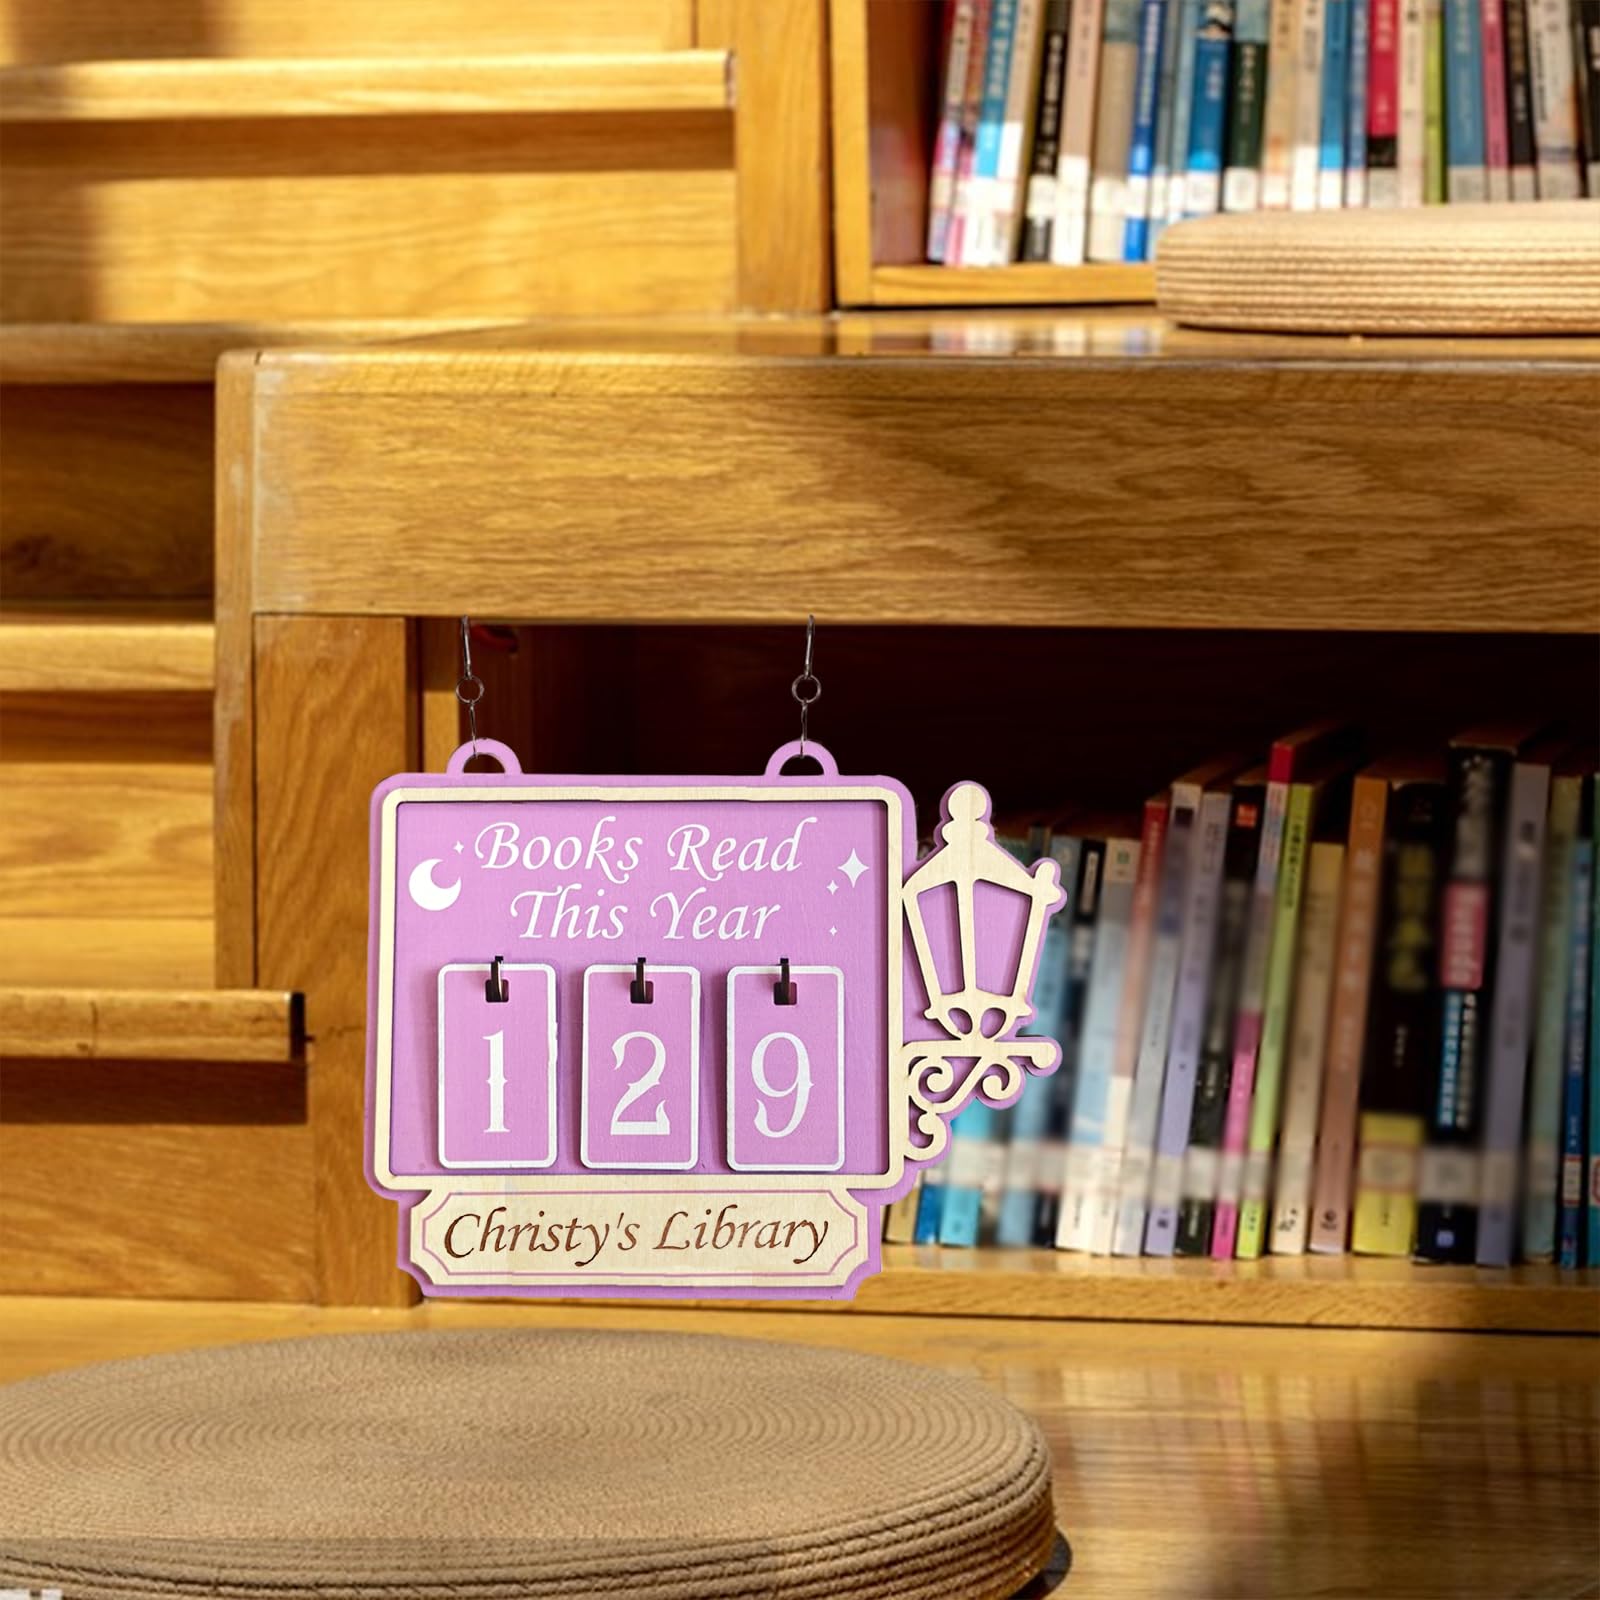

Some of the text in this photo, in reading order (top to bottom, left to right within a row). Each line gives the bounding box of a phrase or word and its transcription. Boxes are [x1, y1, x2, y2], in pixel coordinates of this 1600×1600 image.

[474, 816, 818, 883] Books Read
[509, 883, 781, 940] This Year
[482, 1029, 814, 1138] 1 2 9
[443, 1204, 829, 1267] Christy's Library
